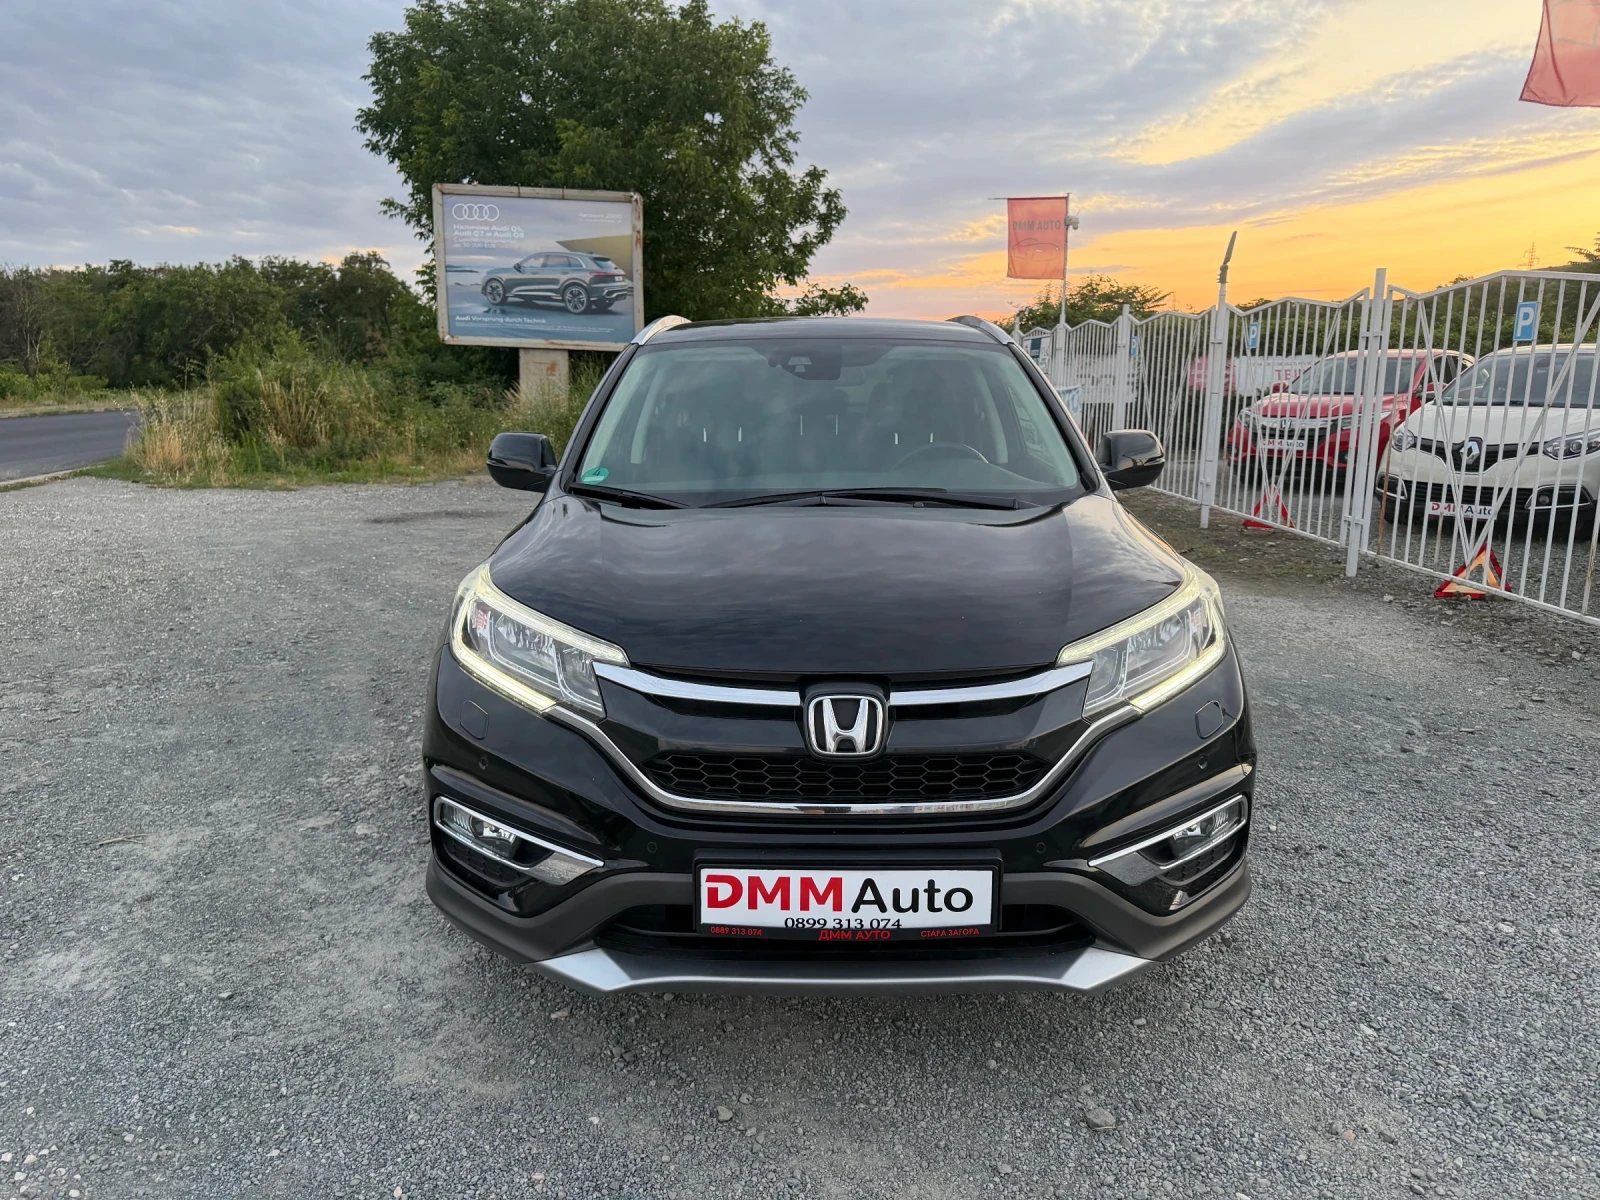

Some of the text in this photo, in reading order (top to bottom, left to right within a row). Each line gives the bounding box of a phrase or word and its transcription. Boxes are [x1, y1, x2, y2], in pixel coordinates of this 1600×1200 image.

[1013, 219, 1061, 231] DMM AUTO
[454, 229, 472, 237] Audi
[1516, 306, 1535, 337] P
[1249, 325, 1258, 346] P
[784, 917, 903, 930] 0899 313 074
[710, 926, 764, 937] 0889 313 074
[817, 929, 892, 942] ДММ АУТО
[920, 927, 981, 939] СТАРА ЗАГОРА
